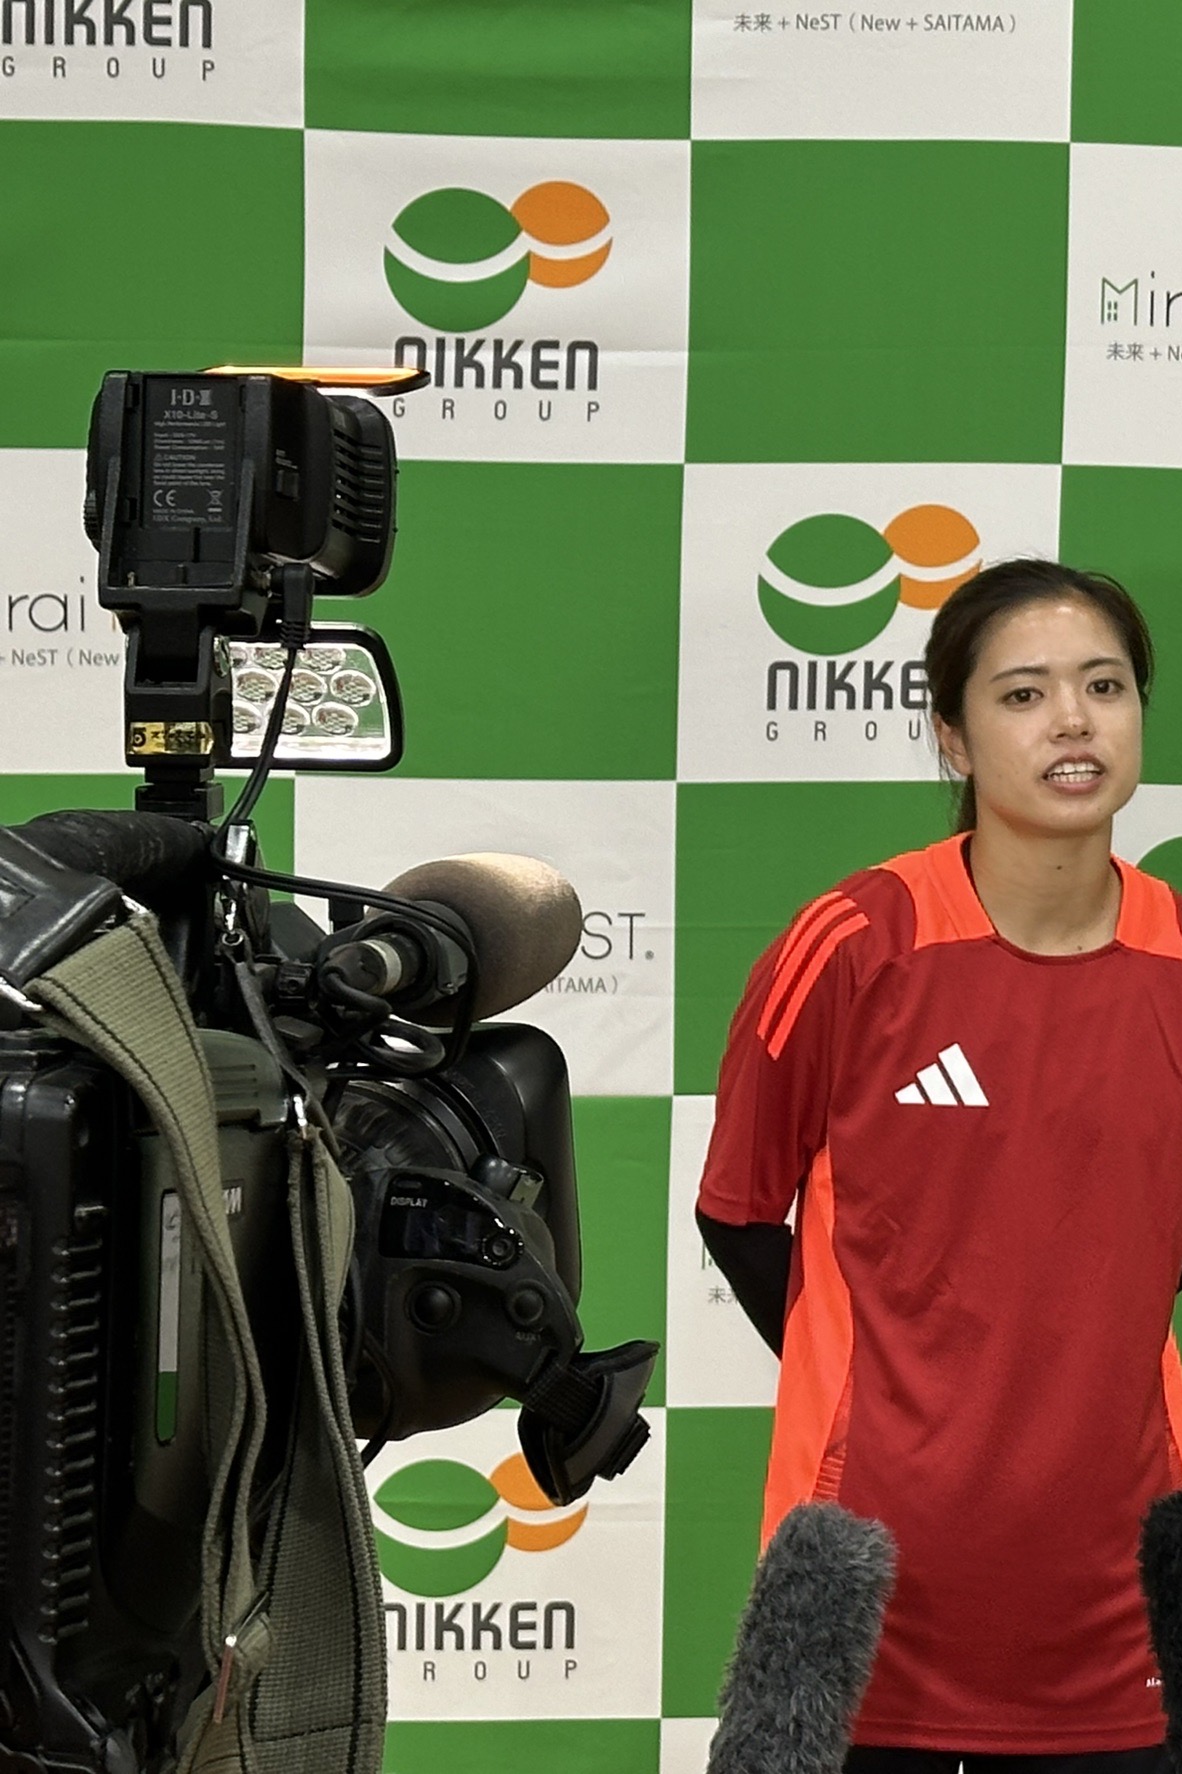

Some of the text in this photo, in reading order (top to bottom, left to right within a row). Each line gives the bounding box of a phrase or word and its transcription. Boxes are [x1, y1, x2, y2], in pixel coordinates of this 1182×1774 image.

[0, 0, 214, 48] NIKKEN
[795, 12, 842, 31] NeST
[2, 55, 215, 81] GROUP
[394, 336, 599, 391] NIKKEN
[392, 398, 600, 422] GROUP
[8, 575, 85, 633] rai
[11, 648, 58, 667] NeST
[766, 660, 929, 711] NIKKE
[766, 721, 921, 742] GROU
[581, 911, 646, 960] ST
[423, 1659, 578, 1681] ROUP
